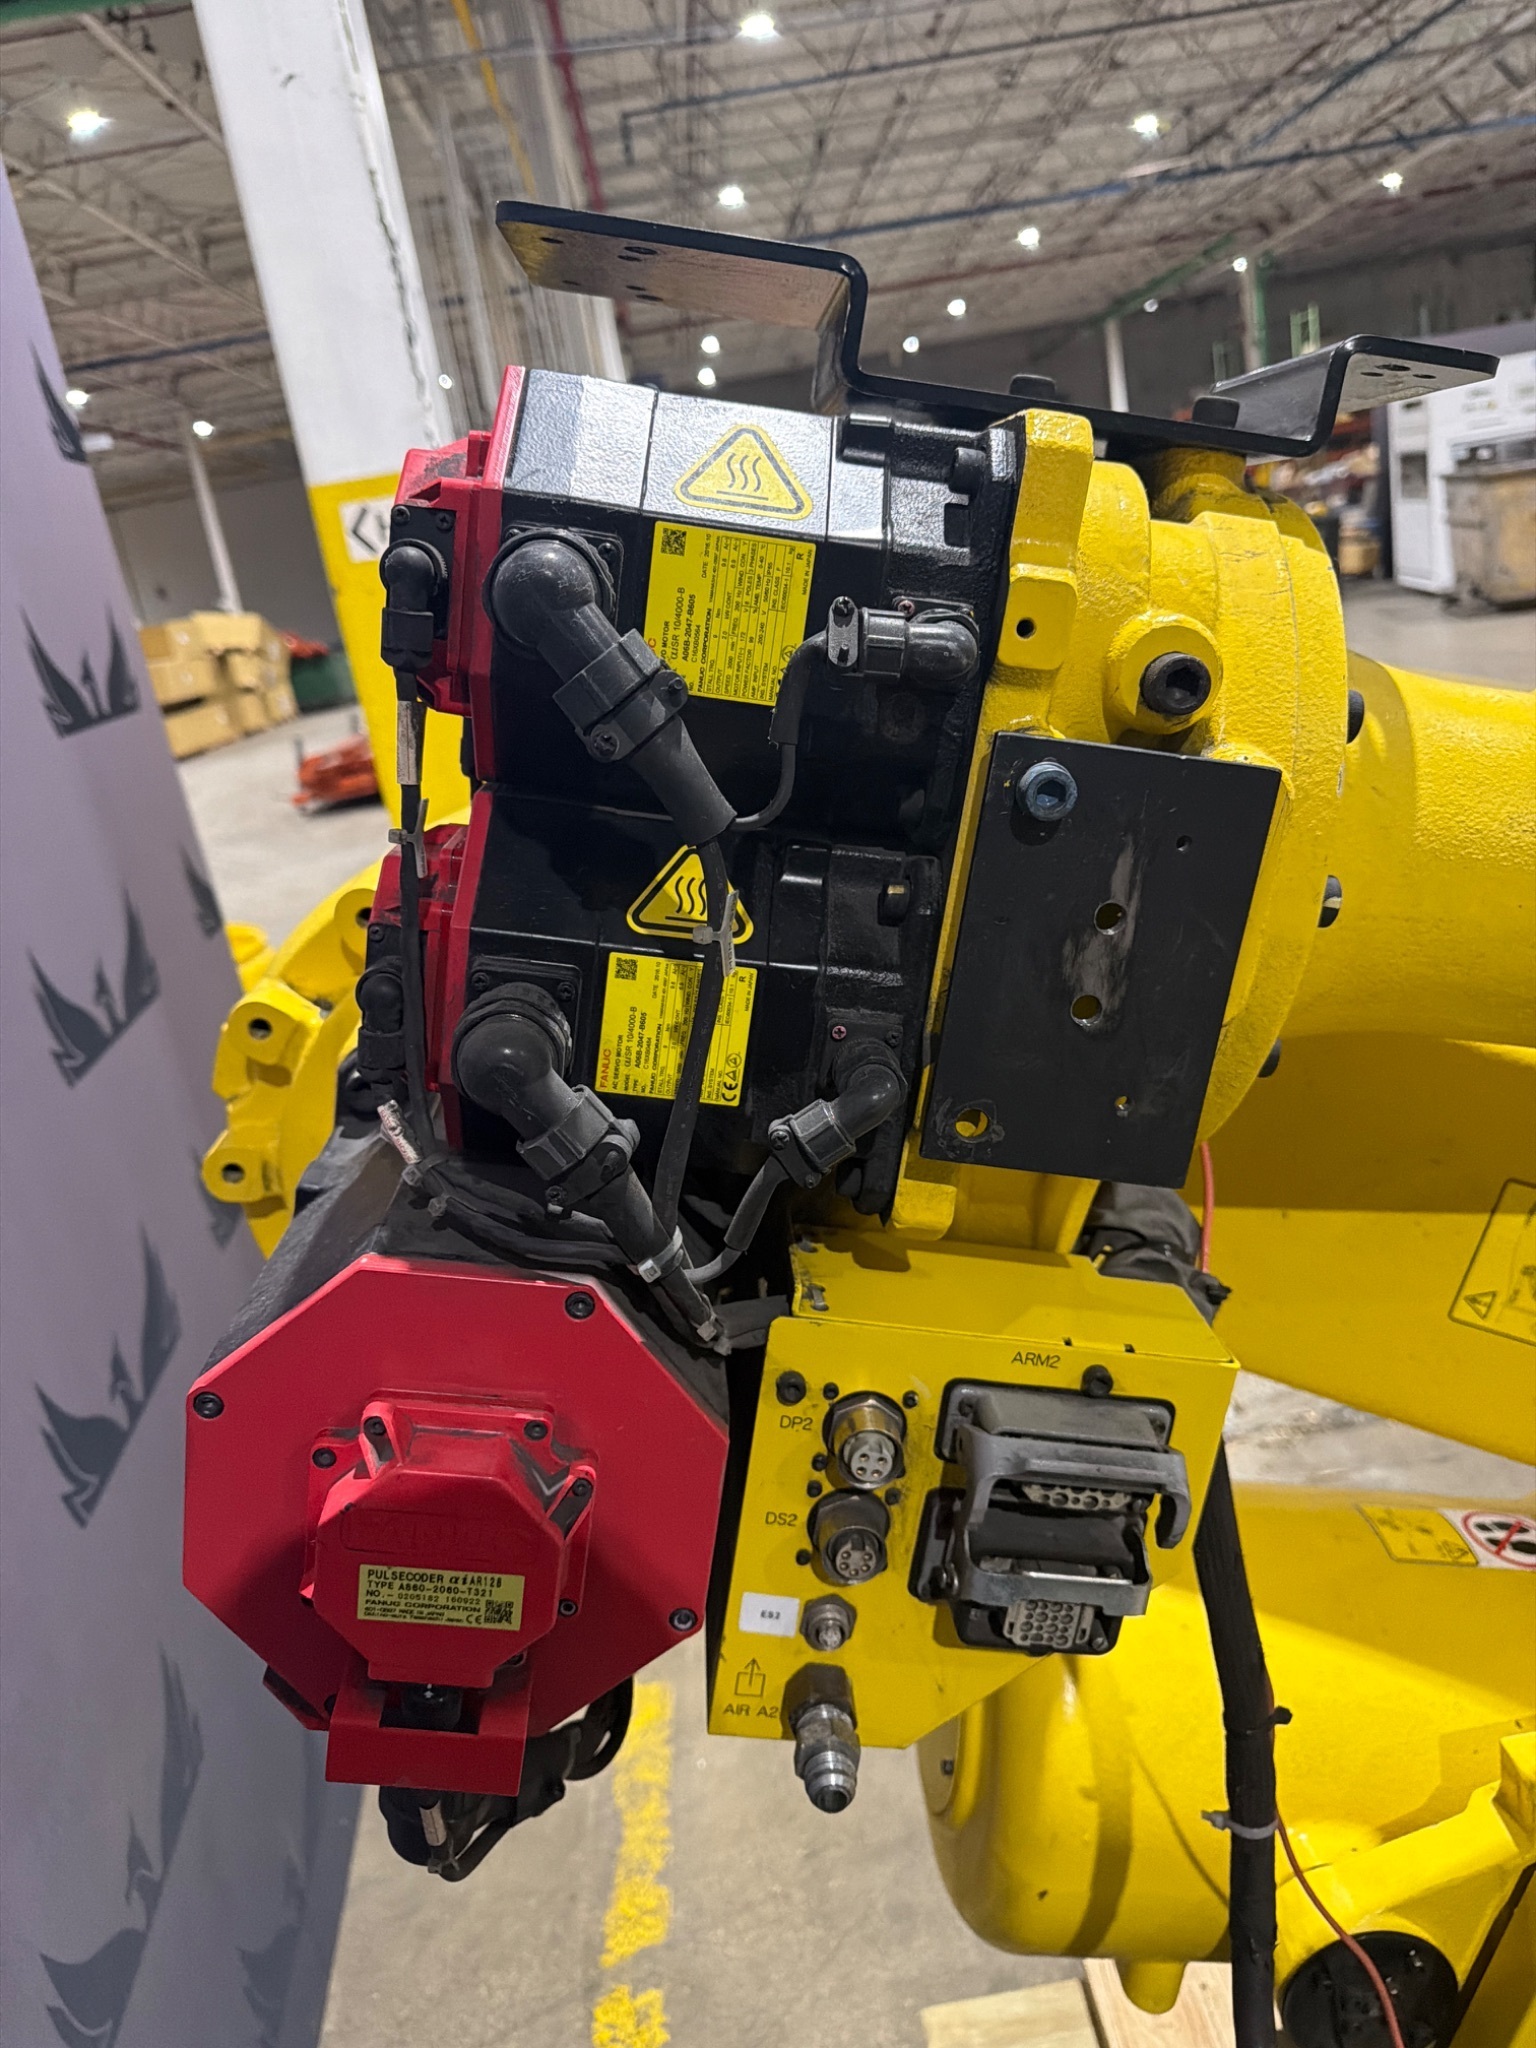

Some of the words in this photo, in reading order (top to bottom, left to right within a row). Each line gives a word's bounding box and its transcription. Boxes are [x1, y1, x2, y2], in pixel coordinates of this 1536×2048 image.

[748, 542, 756, 567] PHASES
[796, 552, 803, 560] R
[672, 586, 685, 630] 10/4000-B
[661, 620, 669, 647] MOTOR
[681, 593, 696, 661] A06B-2047-B605
[700, 608, 711, 664] CORPORATION
[626, 1006, 637, 1042] 10/4000-B
[634, 1012, 646, 1068] A06B-2047-B605
[651, 1023, 661, 1070] CORPORATION
[599, 1048, 611, 1088] FANUC
[612, 1081, 617, 1089] AC
[615, 1034, 623, 1057] MOTOR
[1009, 1351, 1062, 1370] ARM2
[778, 1413, 813, 1431] DP2
[765, 1510, 798, 1528] DS2
[367, 1569, 443, 1583] PULSECODER
[367, 1580, 393, 1589] TYPE
[365, 1598, 400, 1606] FANUC
[404, 1601, 480, 1612] CORPORATION
[446, 1596, 480, 1604] 160922
[723, 1702, 751, 1717] AIR
[756, 1705, 780, 1719] A2
